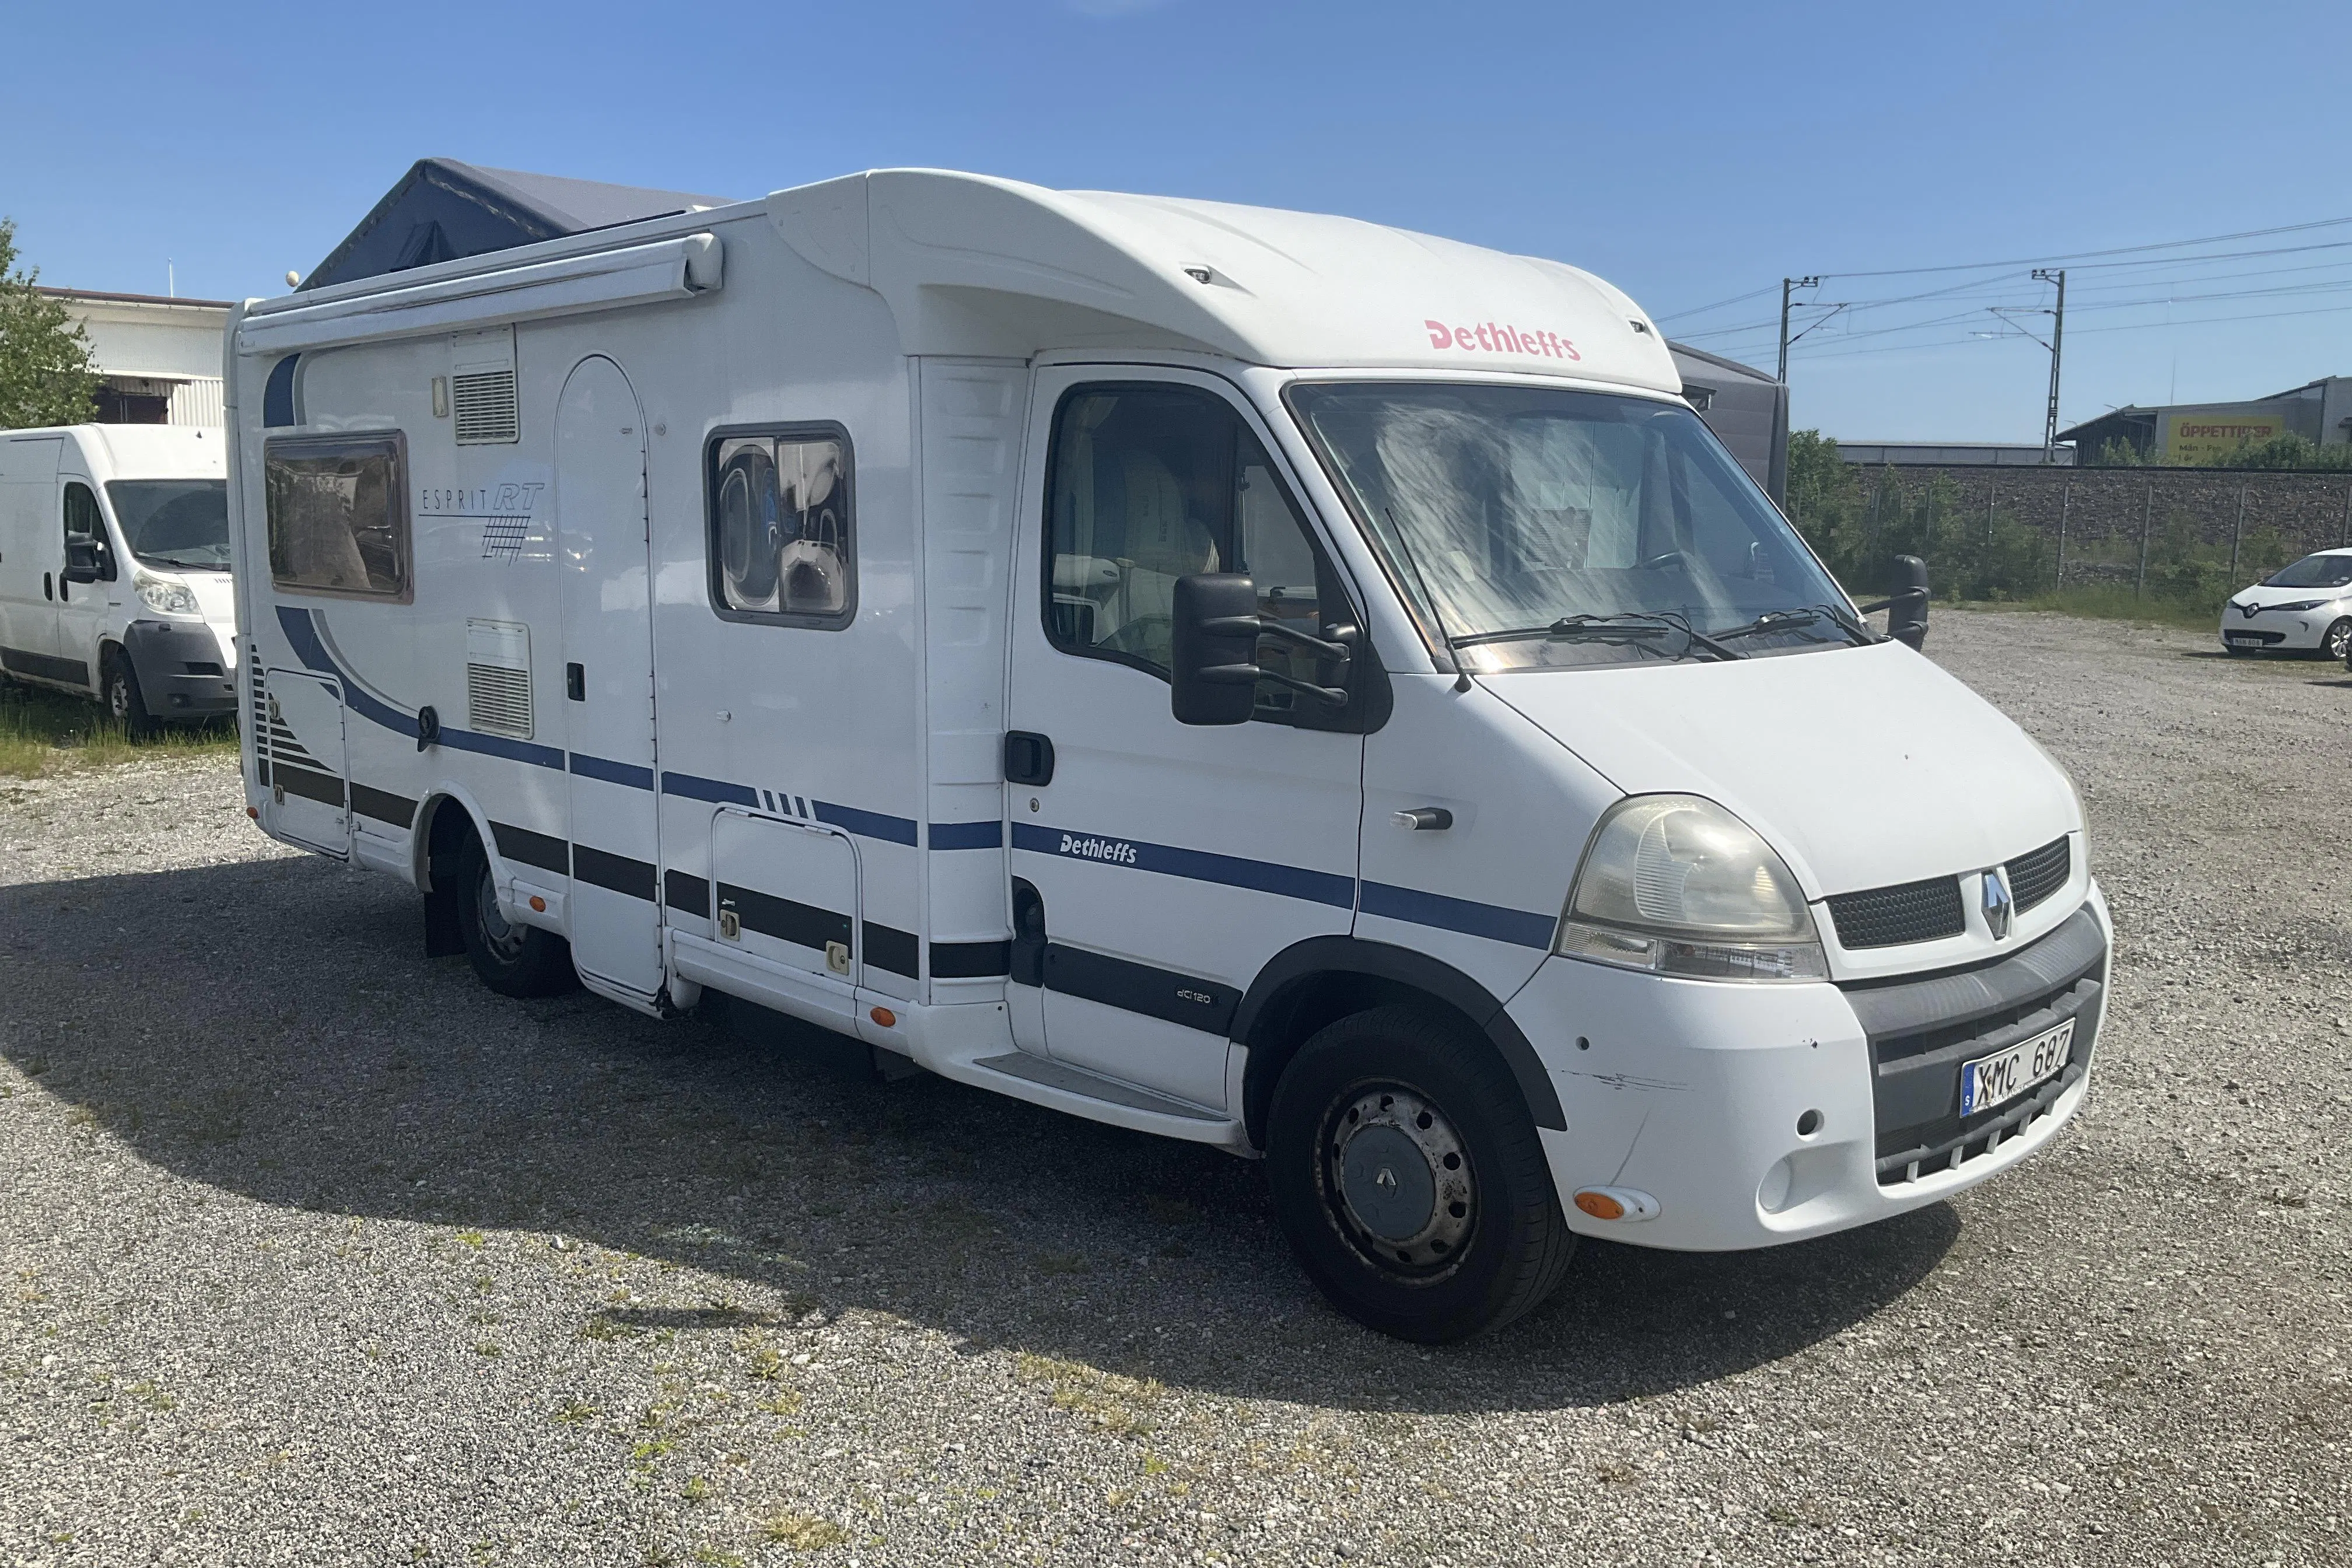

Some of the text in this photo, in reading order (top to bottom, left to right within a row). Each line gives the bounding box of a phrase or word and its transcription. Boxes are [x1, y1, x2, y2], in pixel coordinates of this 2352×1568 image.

[1424, 320, 1581, 361] Dethleffs
[423, 483, 545, 510] ESPRIT RT
[1060, 834, 1137, 863] Dethleffs
[1978, 1053, 2020, 1105] XMC
[2032, 1027, 2070, 1077] 687
[1965, 1095, 1970, 1106] S
